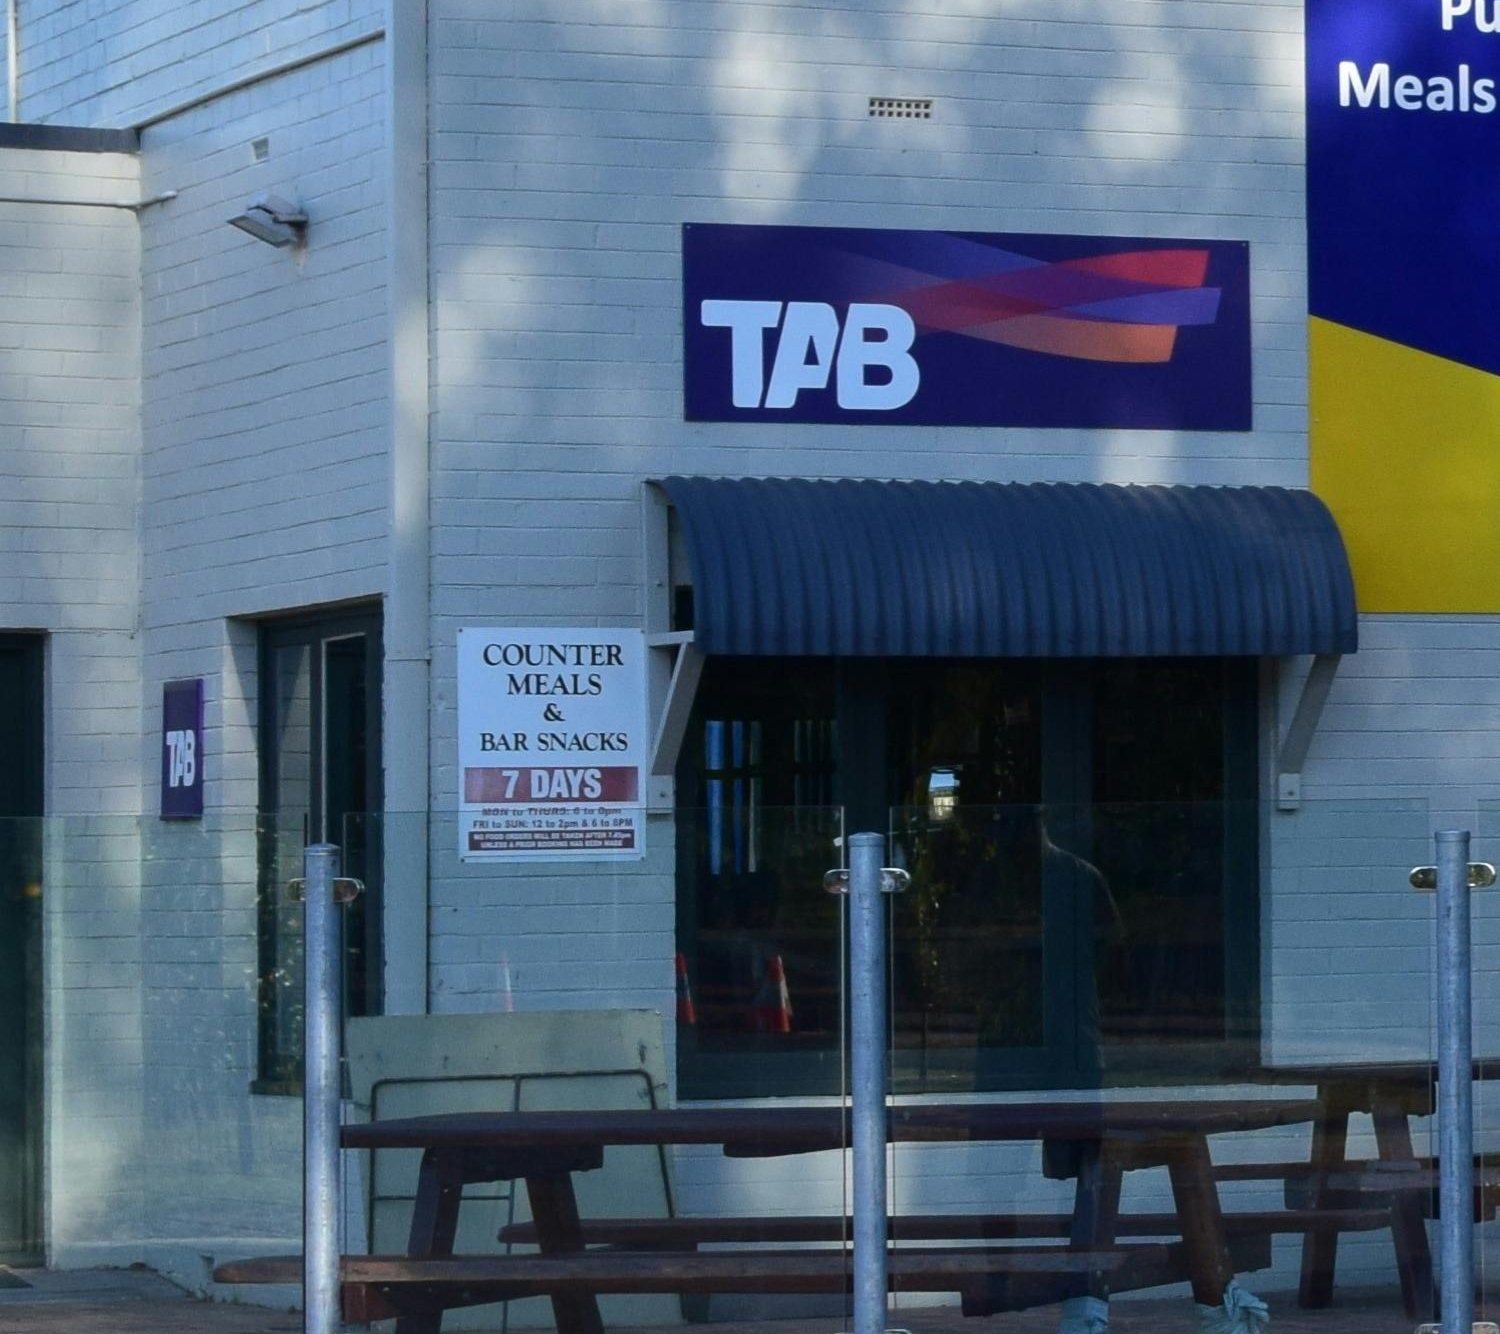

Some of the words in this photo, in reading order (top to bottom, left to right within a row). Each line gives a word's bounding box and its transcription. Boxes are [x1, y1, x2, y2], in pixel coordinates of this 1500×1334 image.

[1338, 61, 1497, 115] Meals
[701, 298, 921, 410] TAB
[483, 644, 624, 667] COUNTER
[507, 674, 602, 696] MEALS
[543, 703, 566, 722] &
[480, 732, 528, 752] BAR
[537, 732, 628, 752] SNACKS
[166, 728, 196, 788] TAB
[502, 770, 520, 799] 7
[530, 768, 602, 799] DAYS
[473, 820, 489, 829] FRI
[492, 820, 501, 829] to
[505, 820, 528, 829] SUN:
[532, 820, 542, 828] 12
[546, 820, 555, 828] to
[558, 820, 578, 830] 2pm
[601, 819, 609, 828] to
